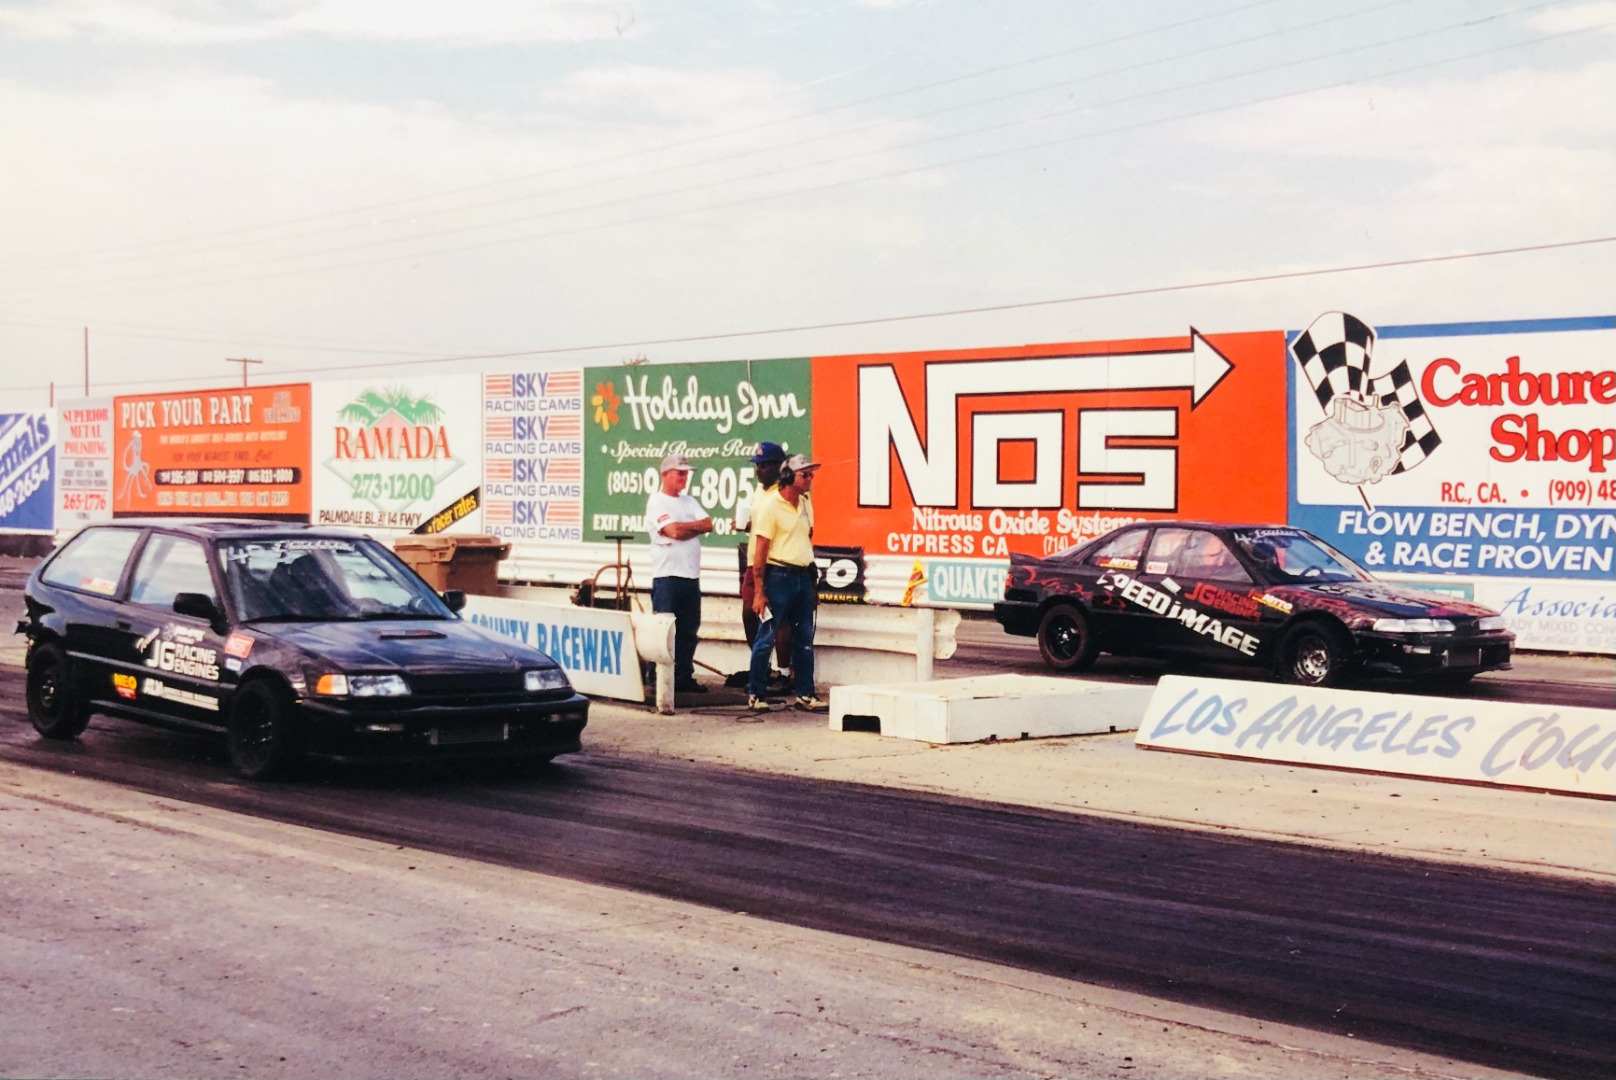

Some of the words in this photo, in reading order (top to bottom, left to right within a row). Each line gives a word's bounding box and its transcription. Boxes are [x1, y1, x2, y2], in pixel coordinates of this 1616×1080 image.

[511, 373, 548, 398] ISKY
[63, 408, 109, 423] SUPERIOR
[121, 400, 156, 428] PICK
[162, 397, 203, 427] YOUR
[210, 395, 253, 425] PART
[486, 400, 535, 413] RACING
[539, 398, 581, 412] CAMS
[624, 375, 732, 435] Holiday
[737, 382, 807, 424] Inn
[70, 424, 102, 440] METAL
[511, 416, 549, 441] ISKY
[857, 345, 1178, 511] NOS
[335, 425, 452, 460] RAMADA
[486, 443, 535, 456] RACING
[539, 441, 581, 455] CAMS
[611, 441, 665, 464] Special
[667, 439, 719, 457] Racer
[721, 438, 759, 458] Rat
[1489, 413, 1616, 473] Shop
[511, 458, 549, 483] ISKY
[607, 470, 643, 495] (805)
[486, 485, 535, 498] RACING
[539, 484, 581, 497] CAMS
[1477, 482, 1507, 504] CA.
[1548, 478, 1592, 506] (909)
[319, 509, 362, 524] PALMDALE
[400, 513, 423, 527] FWY
[432, 510, 456, 533] racer
[456, 494, 478, 518] rates
[511, 500, 549, 525] ISKY
[593, 514, 619, 532] EXIT
[621, 515, 648, 533] PAL
[912, 507, 983, 533] Nitrous
[987, 510, 1049, 536] Oxide
[486, 526, 535, 538] RACING
[539, 525, 581, 540] CAMS
[1338, 510, 1424, 538] FLOW
[1429, 513, 1546, 544] BENCH,
[887, 533, 973, 554] CYPRESS
[981, 536, 1010, 556] CA
[1364, 541, 1385, 566] &
[1393, 543, 1472, 569] RACE
[1477, 545, 1613, 572] PROVEN
[146, 639, 176, 671] JG
[175, 643, 216, 666] RACING
[537, 622, 623, 676] RACEWAY
[174, 659, 219, 681] ENGINES
[1149, 687, 1247, 741] LOS
[1235, 695, 1475, 766] ANGELES
